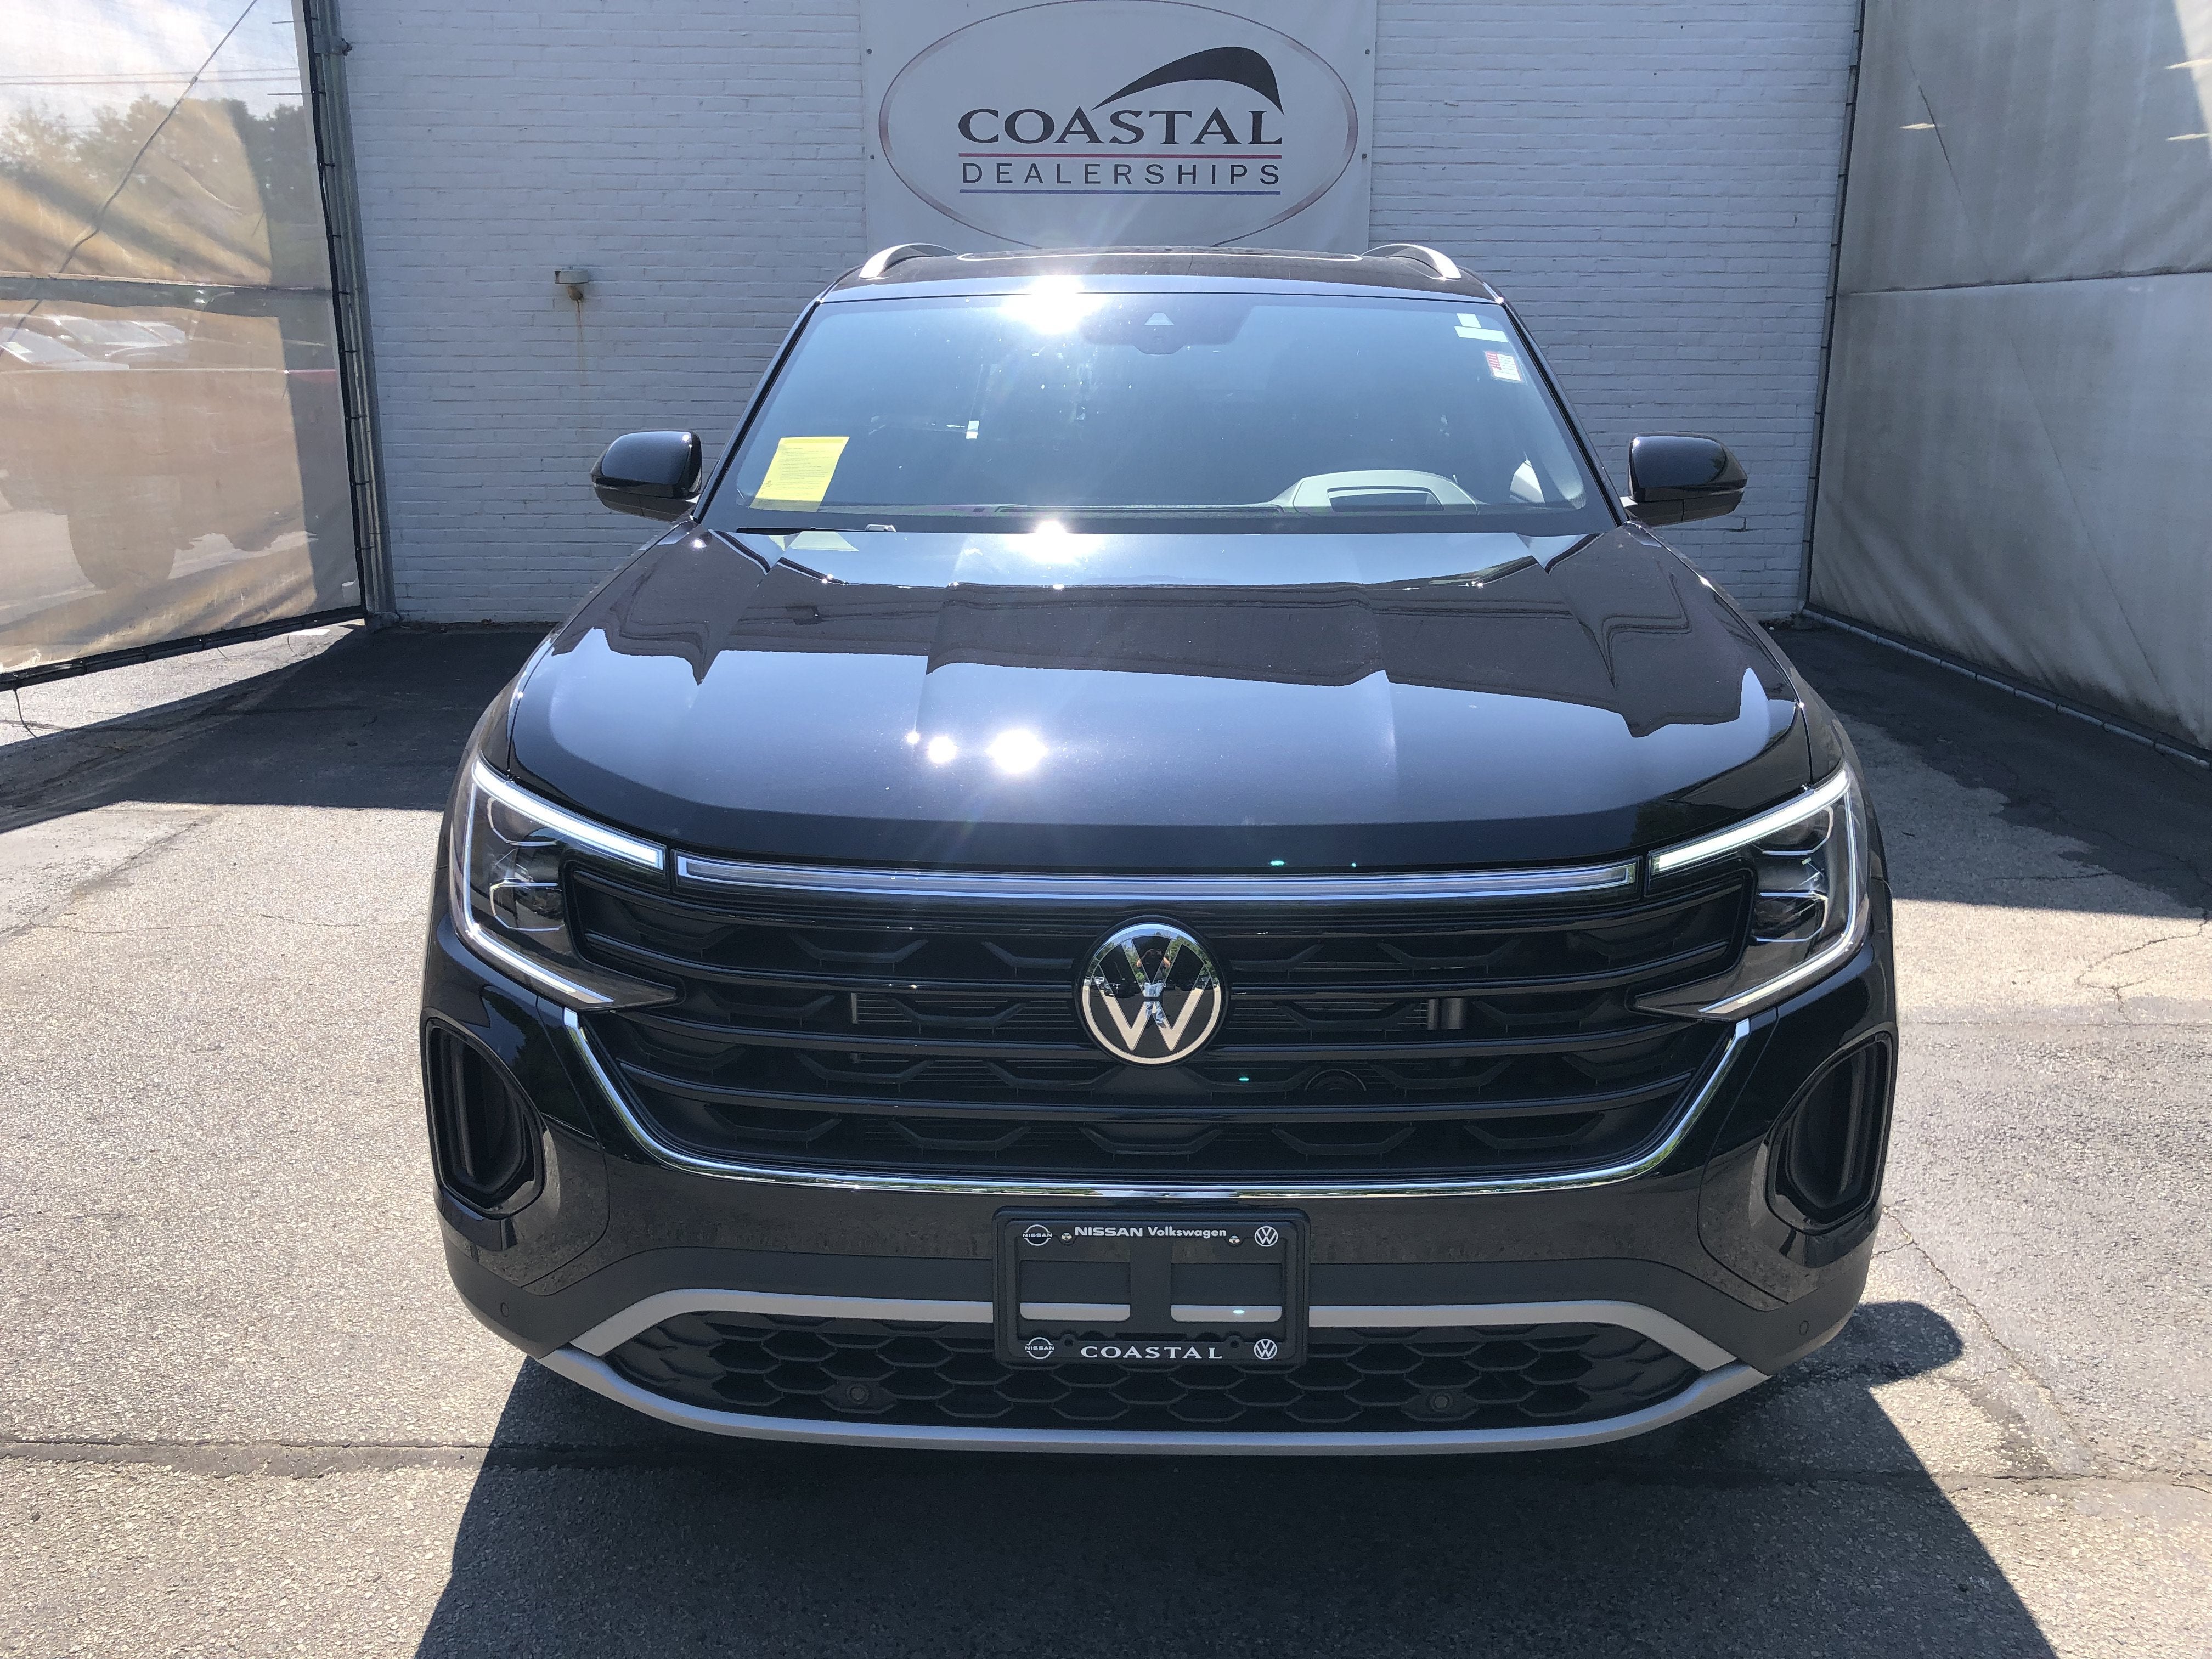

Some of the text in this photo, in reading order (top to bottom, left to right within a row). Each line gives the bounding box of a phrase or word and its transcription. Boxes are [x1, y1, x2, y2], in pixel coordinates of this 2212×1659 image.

[958, 106, 1283, 145] COASTAL
[962, 162, 1280, 185] DEALERSHIPS
[1074, 1226, 1227, 1239] NISSAN Volkswagen
[1080, 1346, 1222, 1360] COASTAL
